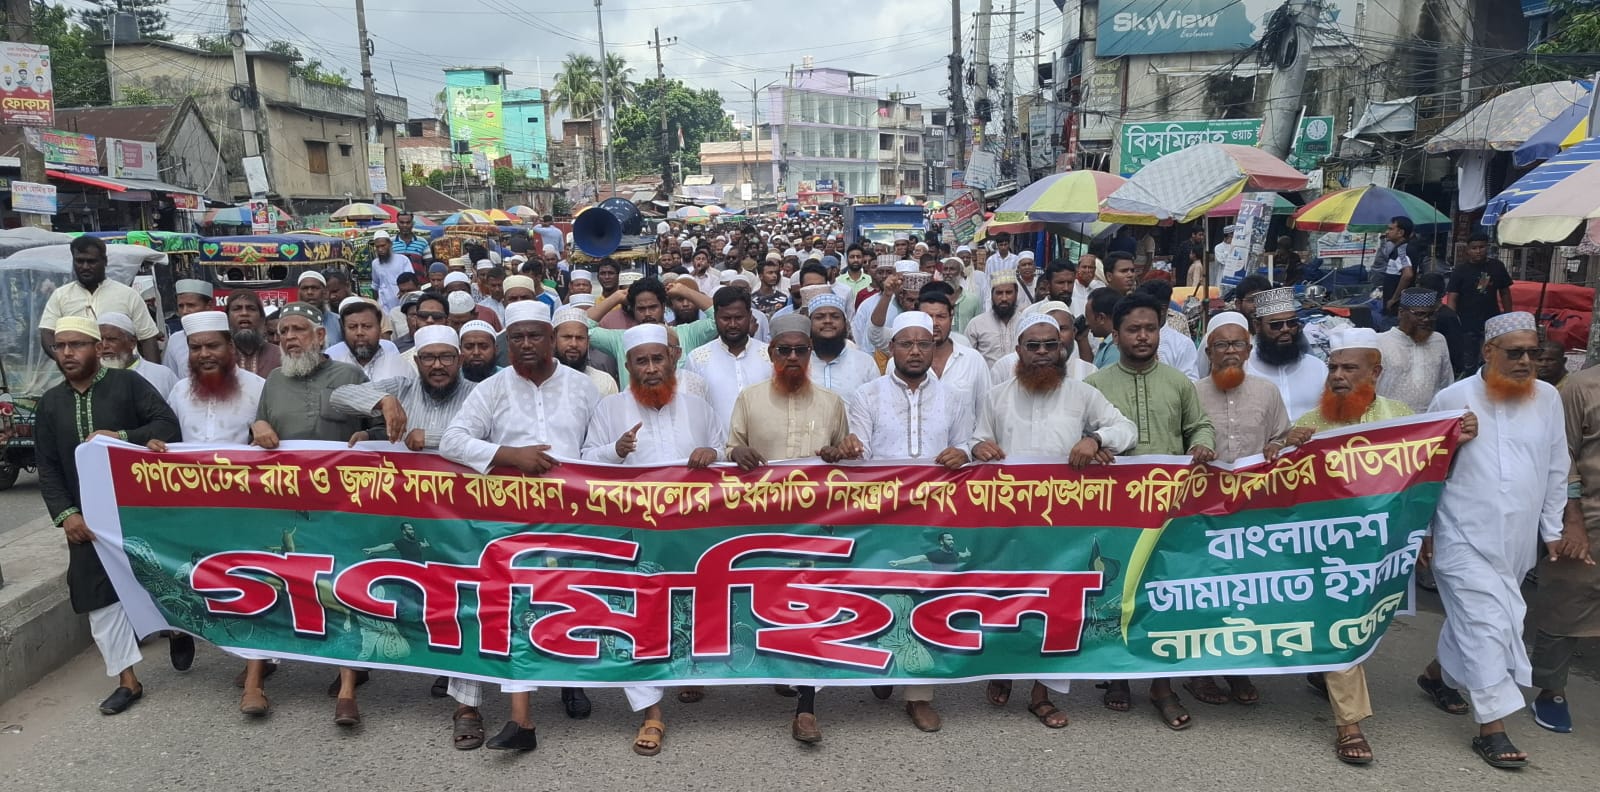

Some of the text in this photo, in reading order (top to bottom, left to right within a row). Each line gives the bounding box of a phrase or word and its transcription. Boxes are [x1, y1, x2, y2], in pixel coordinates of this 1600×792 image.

[1113, 10, 1219, 36] SkyView
[2, 97, 50, 112] ফোকাস
[1232, 129, 1254, 140] ওয়াচ
[131, 452, 252, 493] গণভোটের
[259, 463, 302, 497] রায়
[309, 466, 331, 494] ও
[335, 456, 400, 506] জুলাই
[402, 469, 457, 505] সনদ
[585, 479, 714, 527] দ্রব্যমূল্যের
[824, 469, 904, 513] নিয়ন্ত্রণ
[908, 478, 957, 515] এবং
[965, 468, 1118, 526] আইনশৃঙ্খলা
[1206, 511, 1389, 559] বাংলাদেশ
[190, 532, 1103, 670] গণমিছিল
[1145, 568, 1314, 612] জামায়াতে
[1148, 616, 1314, 661] নাটোর
